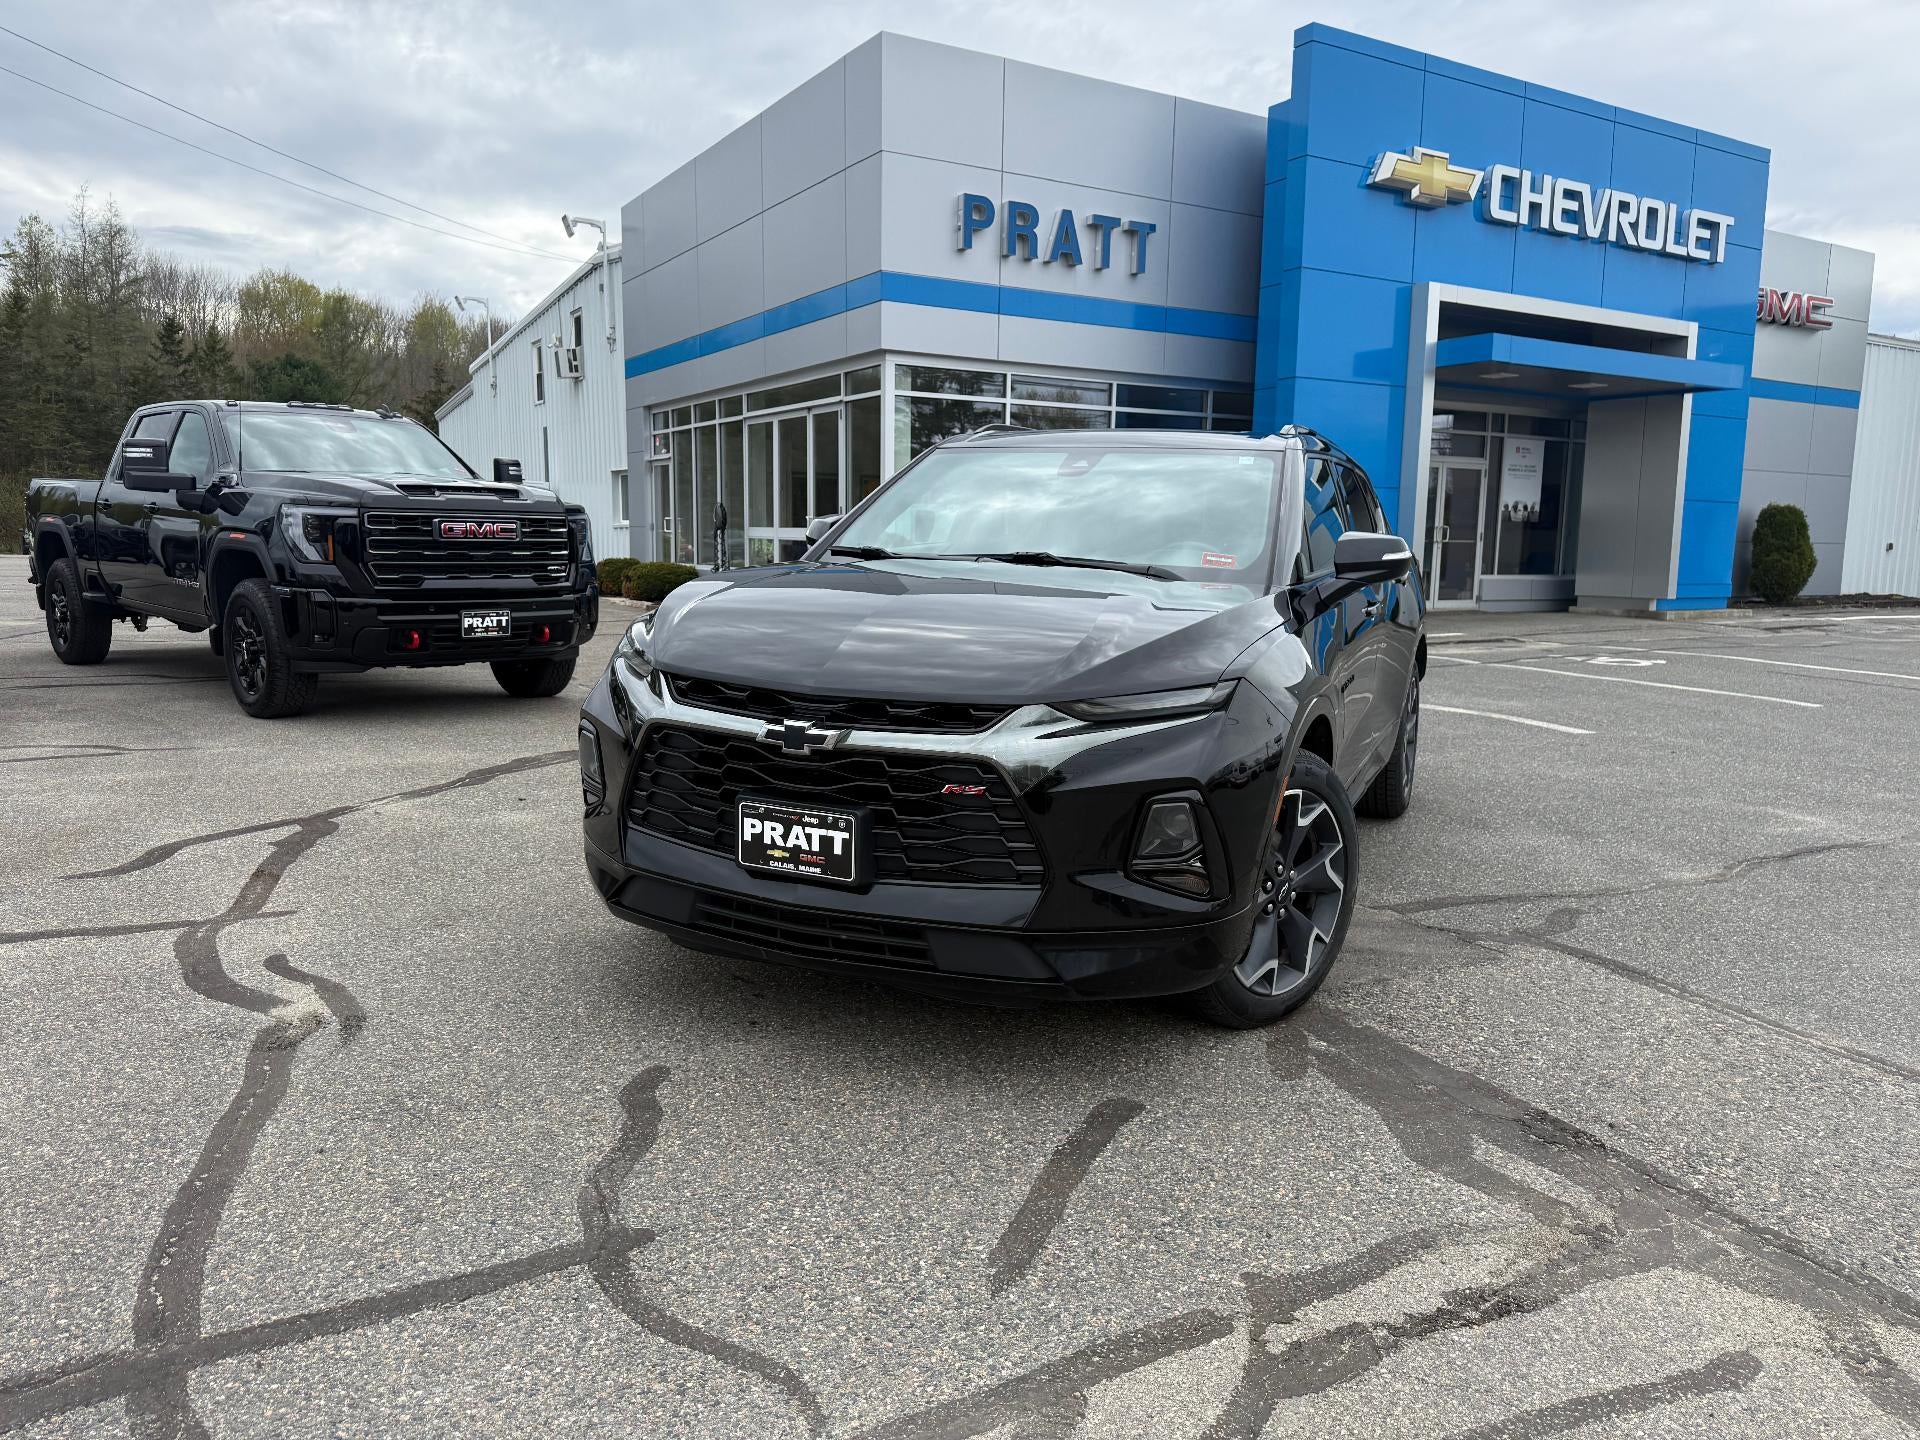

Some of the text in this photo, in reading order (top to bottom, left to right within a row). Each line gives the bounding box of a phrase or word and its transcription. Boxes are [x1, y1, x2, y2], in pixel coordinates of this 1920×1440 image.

[1486, 163, 1735, 264] CHEVROLET
[958, 192, 1157, 275] PRATT
[441, 522, 517, 539] GMC
[464, 616, 509, 628] PRATT
[940, 784, 986, 795] RS
[802, 815, 819, 825] Jeep
[743, 816, 850, 856] PRATT
[799, 853, 826, 864] GMC
[769, 860, 822, 874] CALAIS, MAINE
